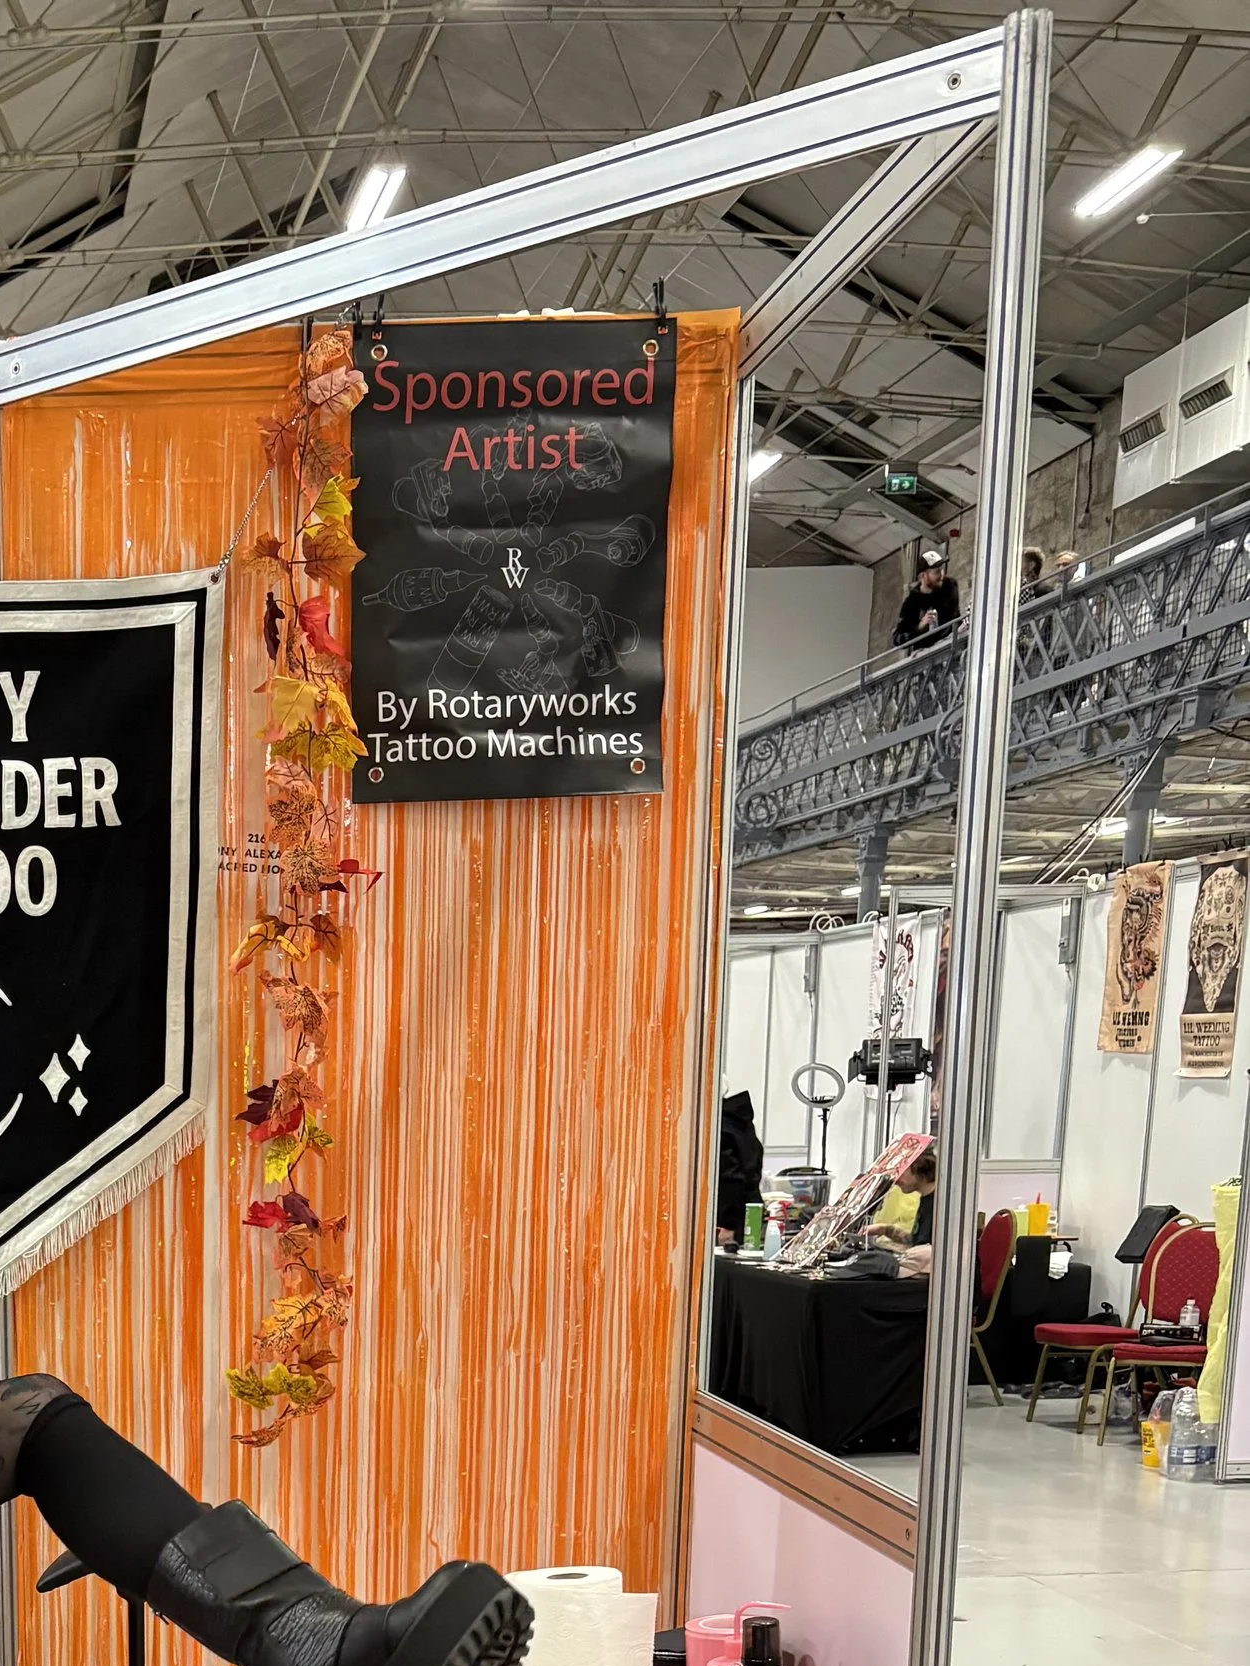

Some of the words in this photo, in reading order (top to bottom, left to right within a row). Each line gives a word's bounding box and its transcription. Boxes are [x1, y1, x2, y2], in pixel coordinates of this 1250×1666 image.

[372, 361, 654, 424] Sponsored
[442, 426, 584, 471] Artist
[377, 691, 418, 730] By
[428, 684, 637, 727] Rotaryworks
[368, 730, 477, 763] Tattoo
[487, 728, 645, 758] Machines
